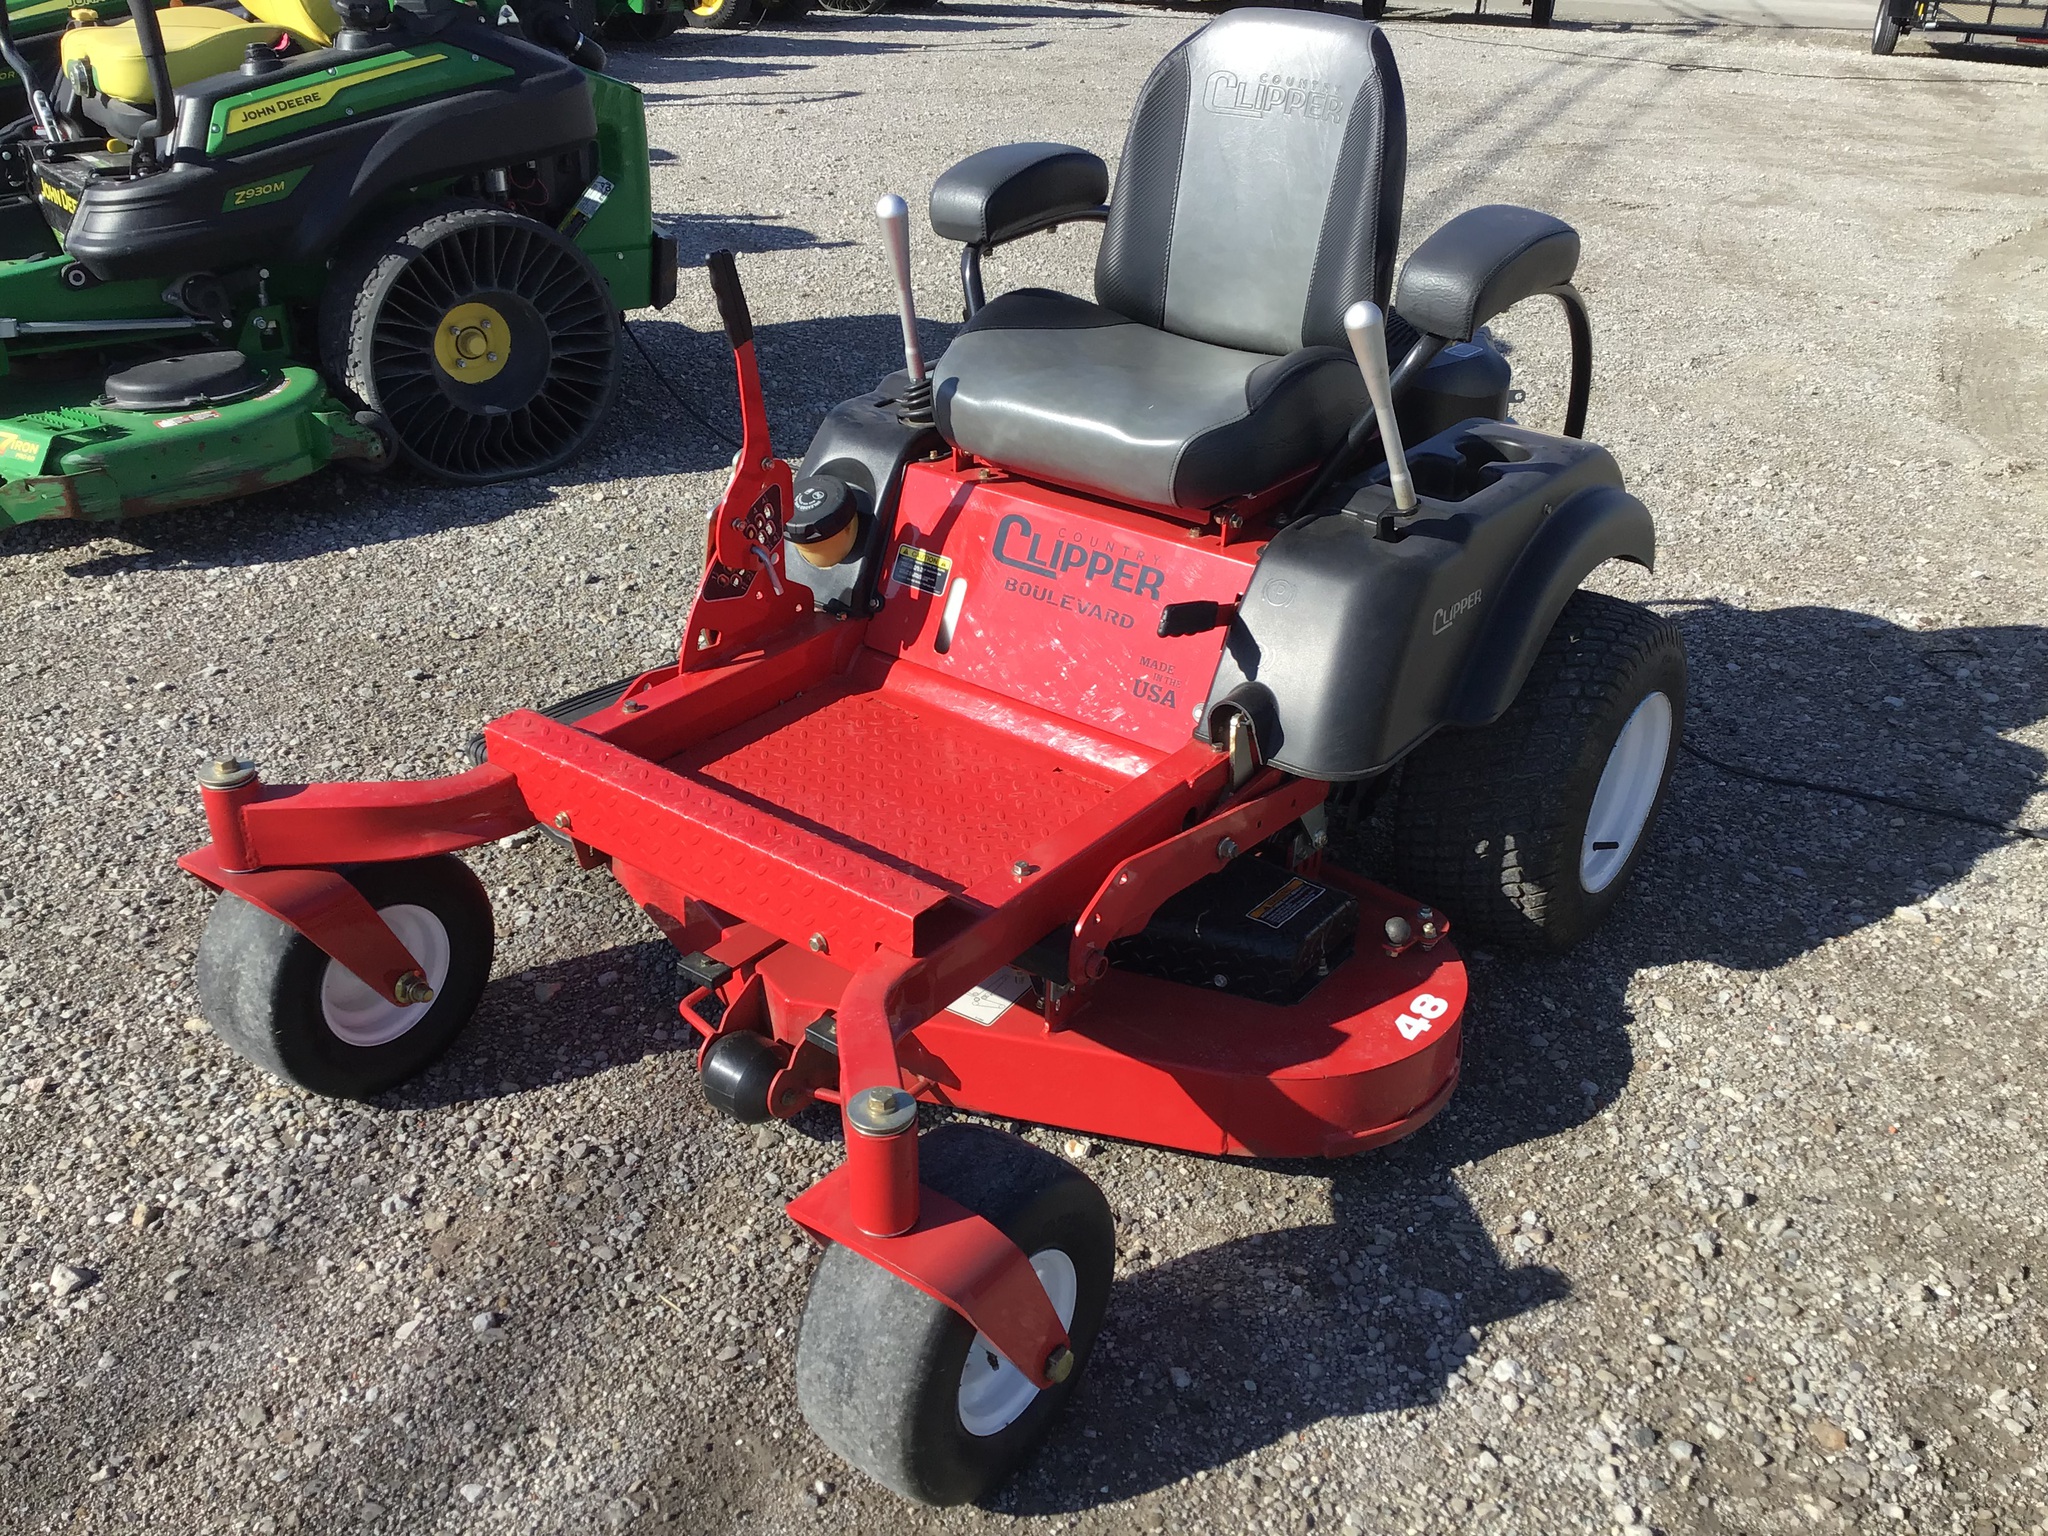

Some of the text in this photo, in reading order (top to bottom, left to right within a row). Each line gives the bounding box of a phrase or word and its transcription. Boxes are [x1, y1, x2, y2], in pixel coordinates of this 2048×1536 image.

[1202, 69, 1344, 124] CLIPPER
[1259, 72, 1342, 95] COUNTRY
[241, 92, 321, 123] JOHN DEERE
[40, 176, 62, 207] JOHN
[234, 181, 285, 205] Z930M
[911, 551, 940, 565] CAUTION
[992, 513, 1166, 601] CLIPPER
[1058, 528, 1162, 566] COUNTRY
[1004, 577, 1135, 629] BOULEVARD
[1432, 588, 1482, 636] CLIPPER
[1139, 656, 1176, 675] MADE
[1153, 673, 1182, 688] IN THE
[1132, 678, 1176, 709] USA
[1394, 993, 1449, 1041] 48
